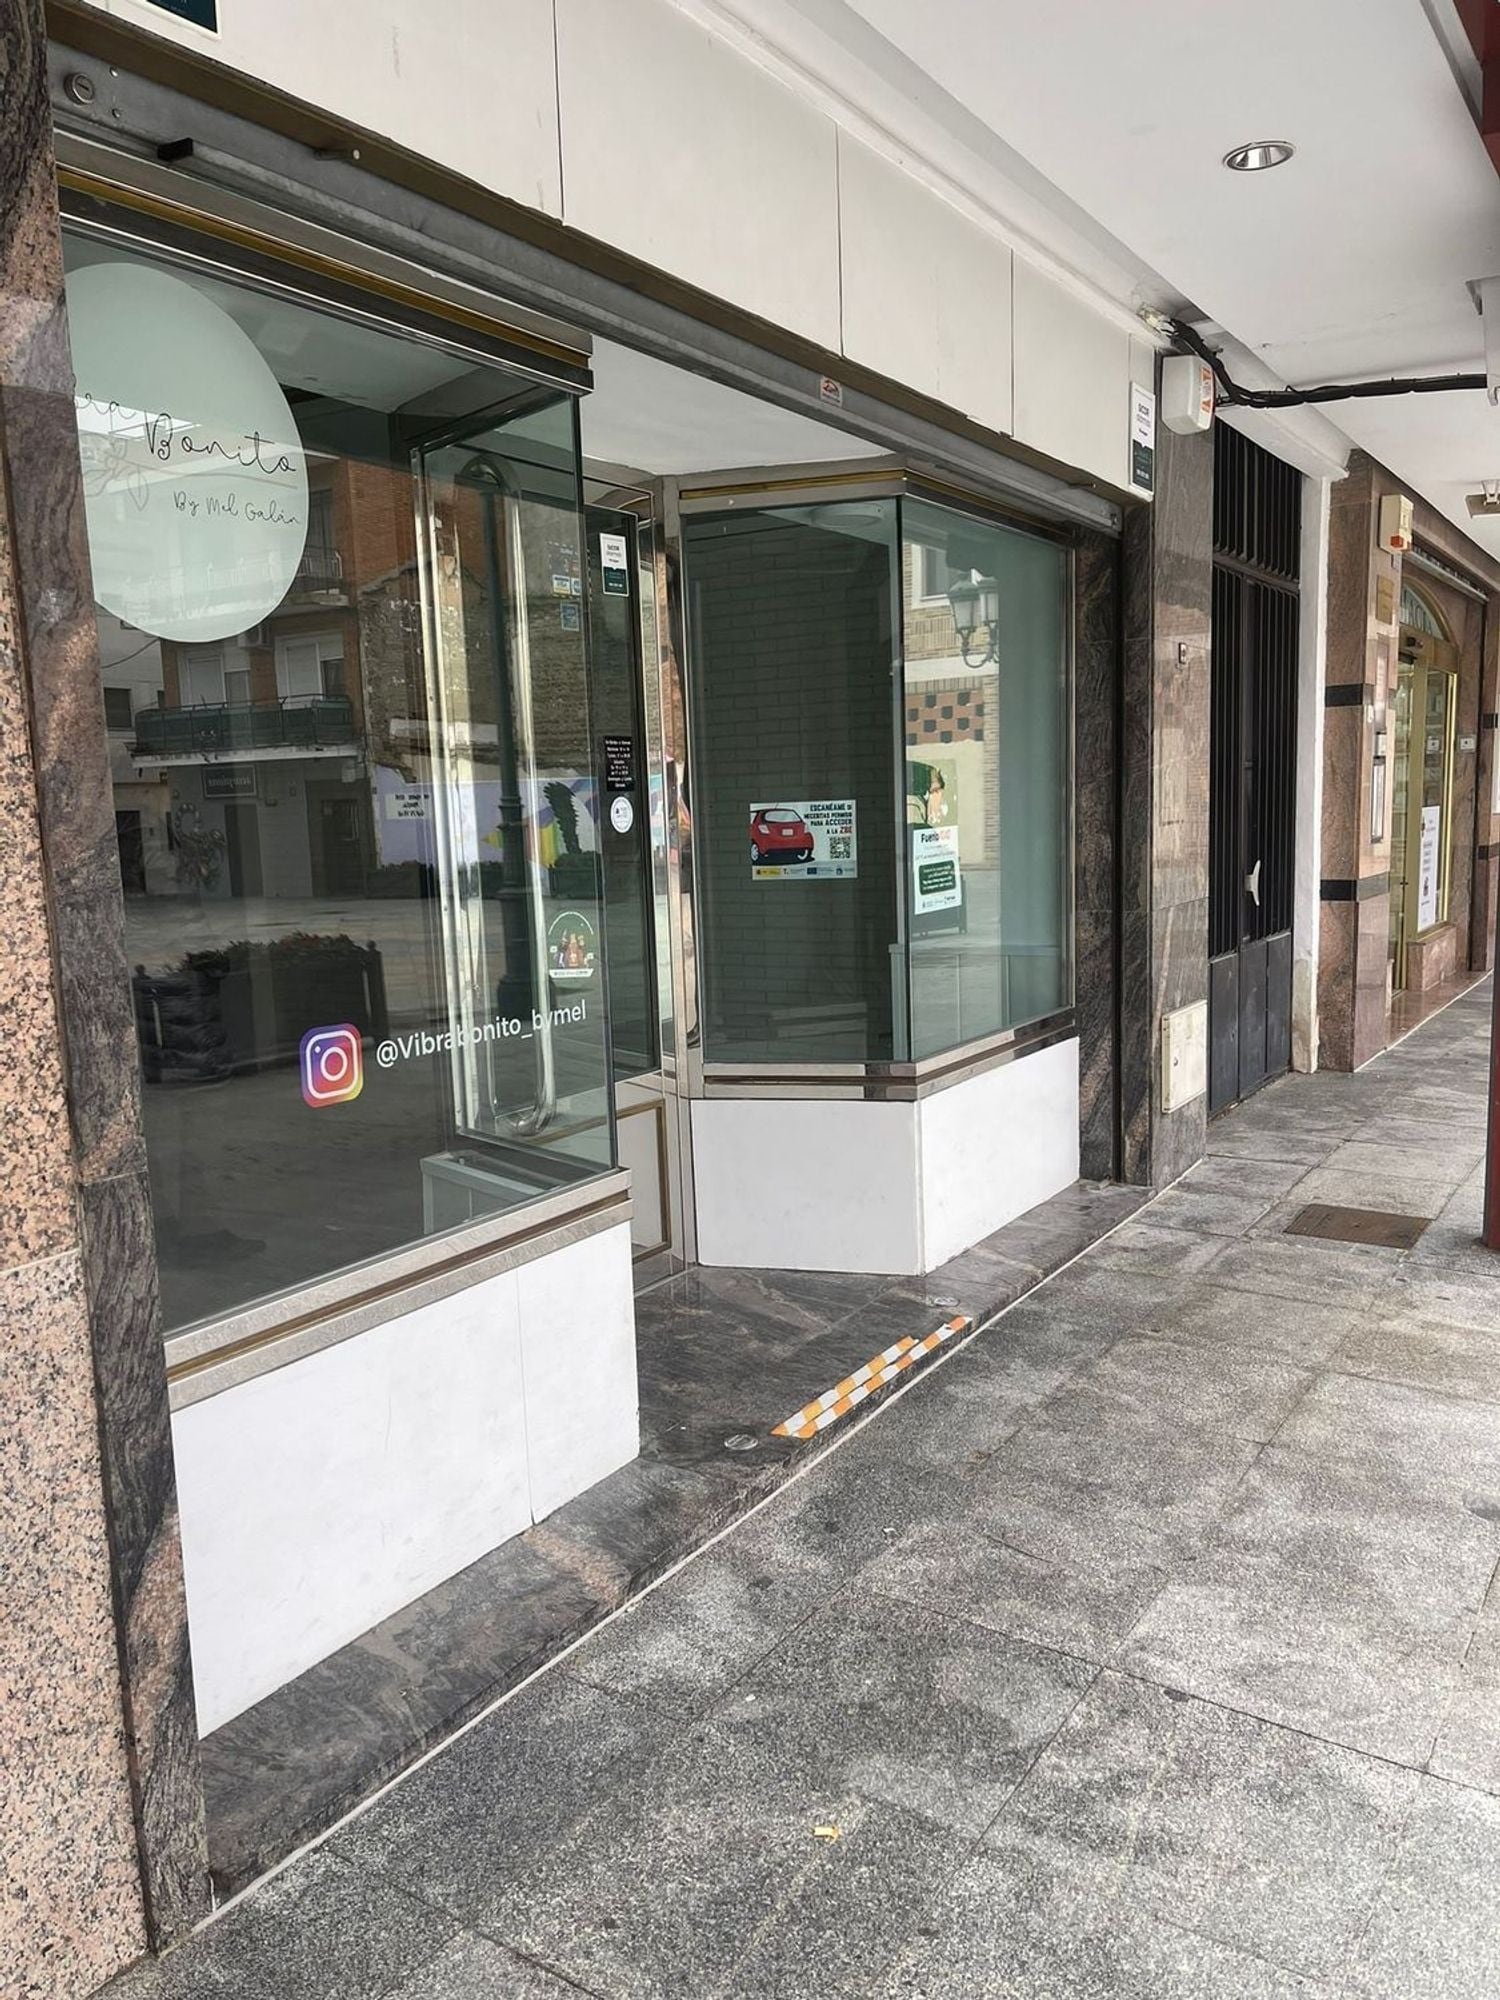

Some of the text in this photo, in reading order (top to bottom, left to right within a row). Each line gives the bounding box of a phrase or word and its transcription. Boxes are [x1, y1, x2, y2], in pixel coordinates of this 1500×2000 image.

[145, 410, 296, 474] Bonito
[173, 491, 200, 516] By
[206, 493, 239, 517] Mel
[376, 1000, 586, 1068] @Vibrabonito_bymel
